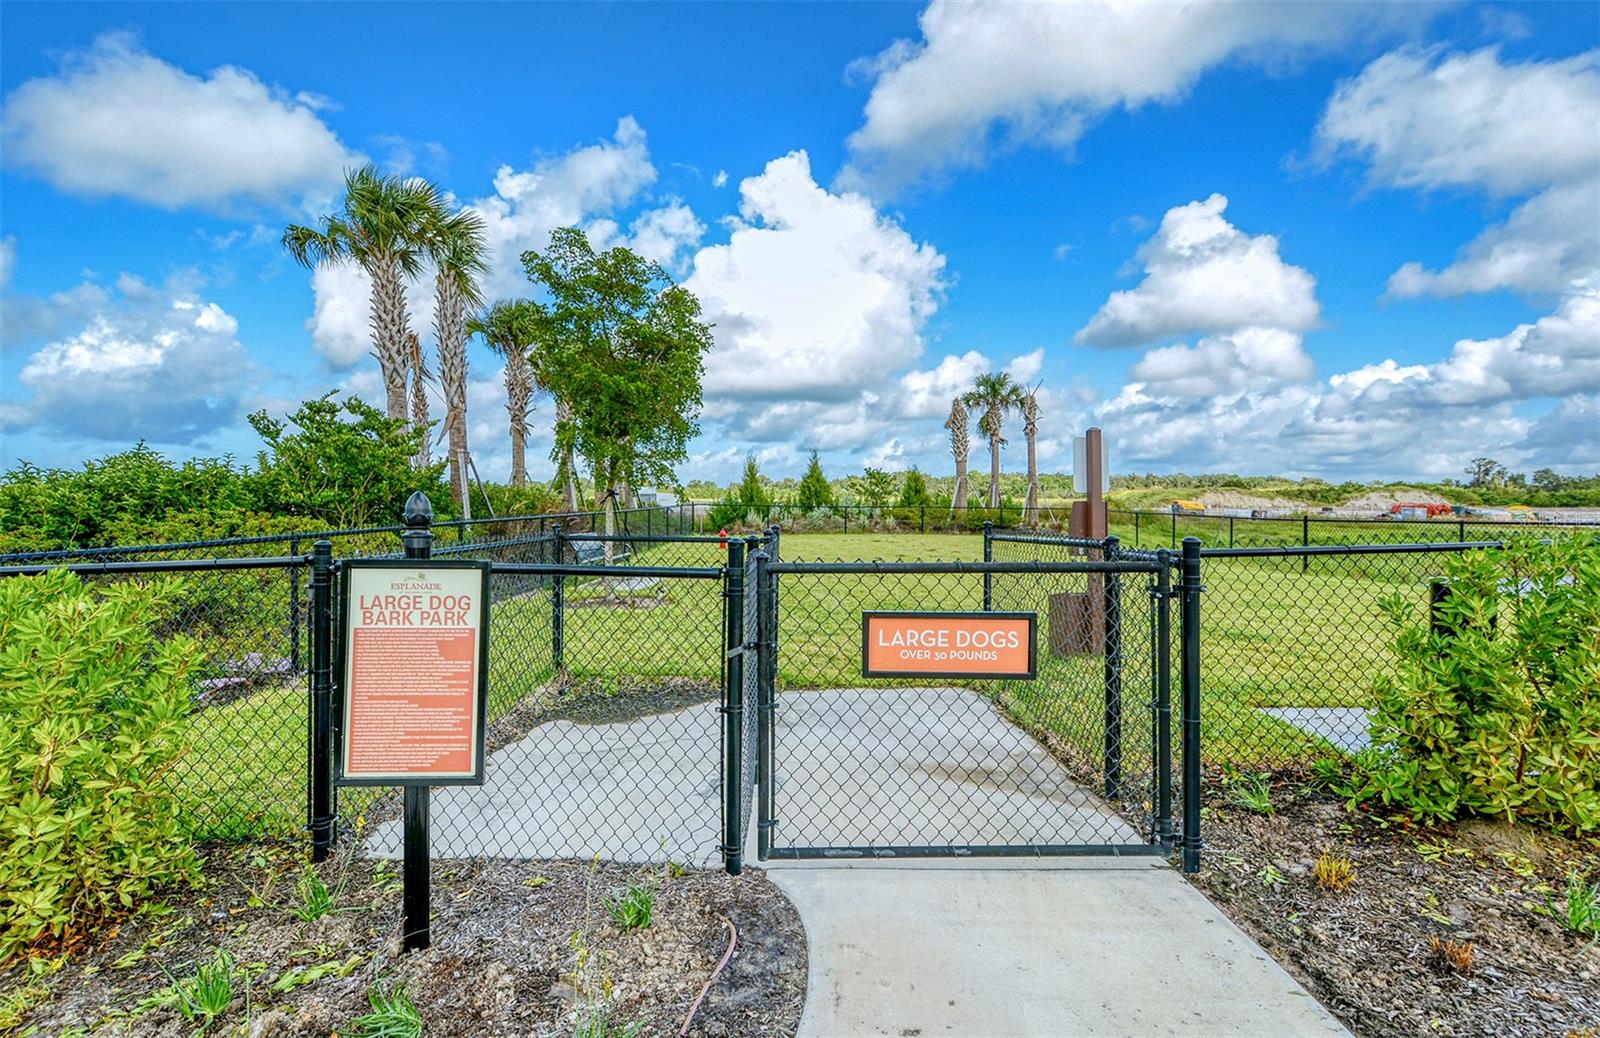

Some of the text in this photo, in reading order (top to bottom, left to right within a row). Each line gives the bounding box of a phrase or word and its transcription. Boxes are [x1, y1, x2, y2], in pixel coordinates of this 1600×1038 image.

[390, 583, 442, 591] ESPLANADE
[360, 595, 471, 611] LARGE DOG
[362, 611, 468, 626] BARK PARK
[879, 629, 1019, 648] LARGE DOGS
[899, 650, 998, 661] OVER 30 POUNDS
